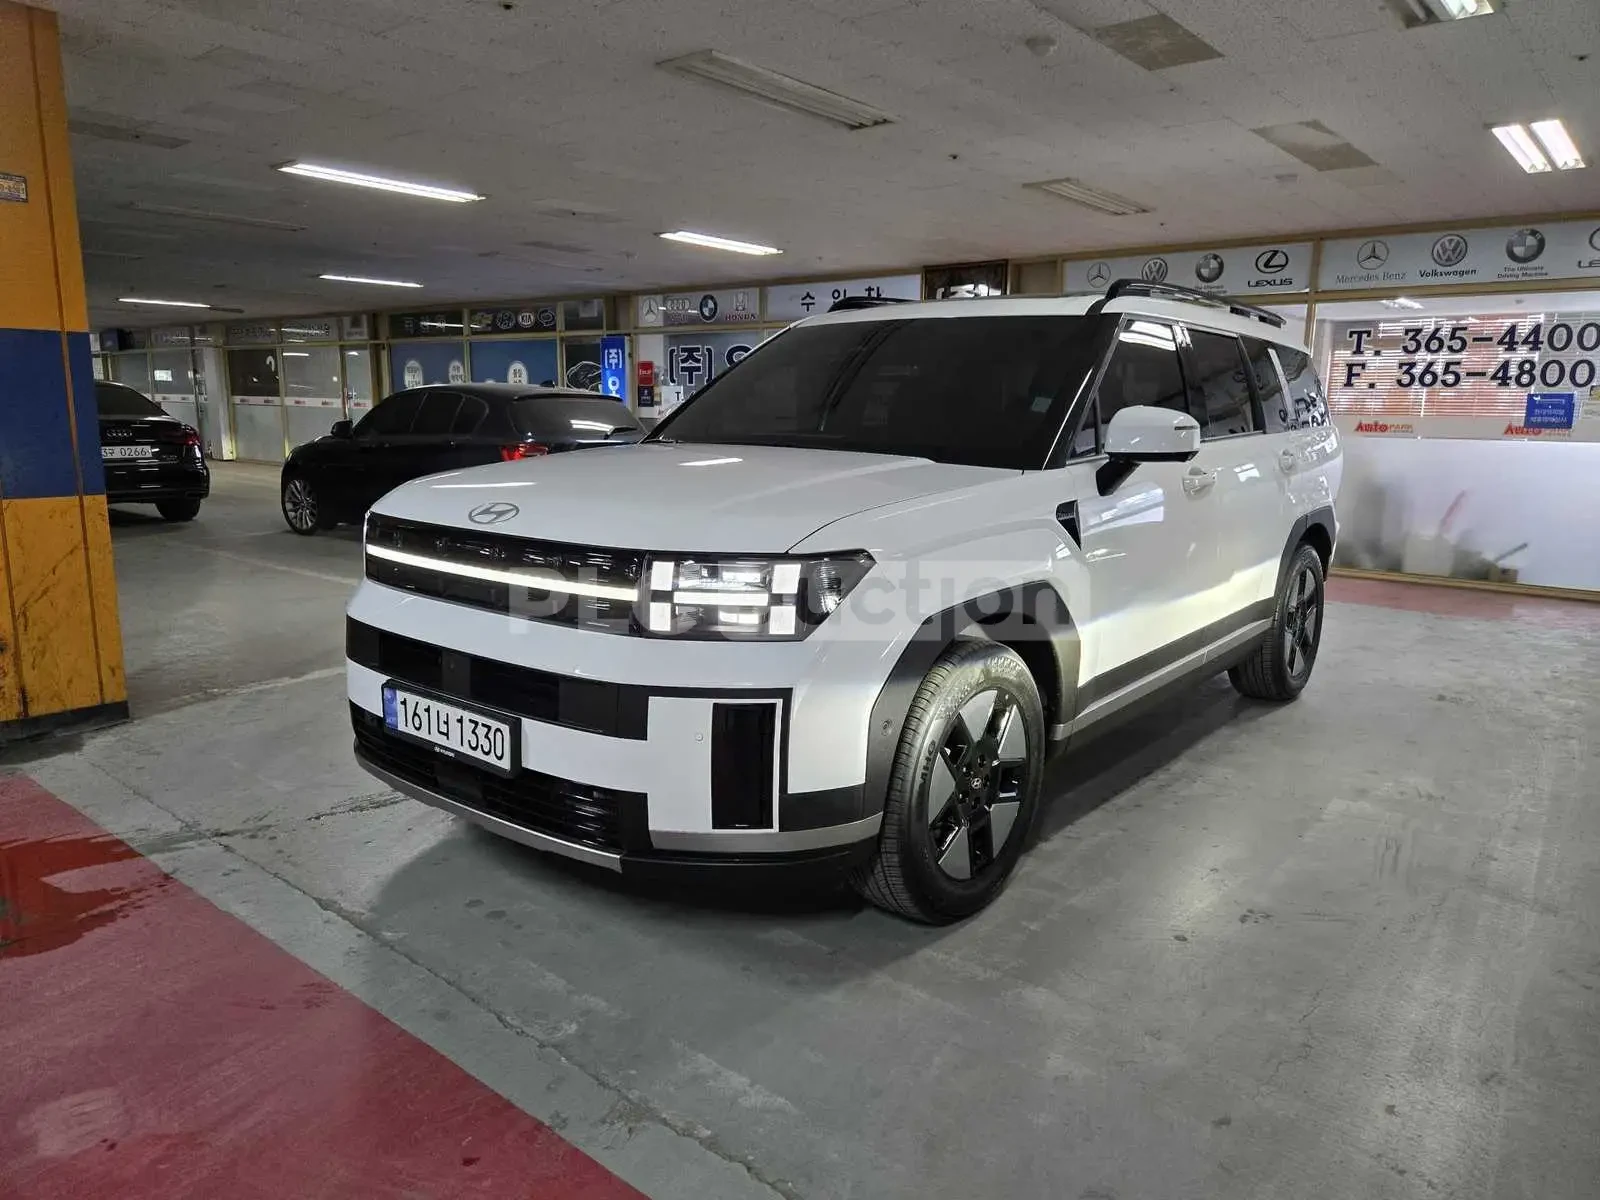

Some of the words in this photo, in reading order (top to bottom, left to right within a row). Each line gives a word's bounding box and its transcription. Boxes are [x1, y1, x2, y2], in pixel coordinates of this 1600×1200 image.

[1336, 273, 1379, 284] Mercedes
[1383, 271, 1407, 281] Benz
[1419, 269, 1477, 278] Volkswagen
[1248, 278, 1292, 287] LEXUS
[725, 313, 755, 321] HONDA
[1402, 322, 1600, 353] 365-4400
[1396, 359, 1596, 388] 365-4800
[1354, 420, 1388, 432] Auto
[120, 447, 147, 456] 0266
